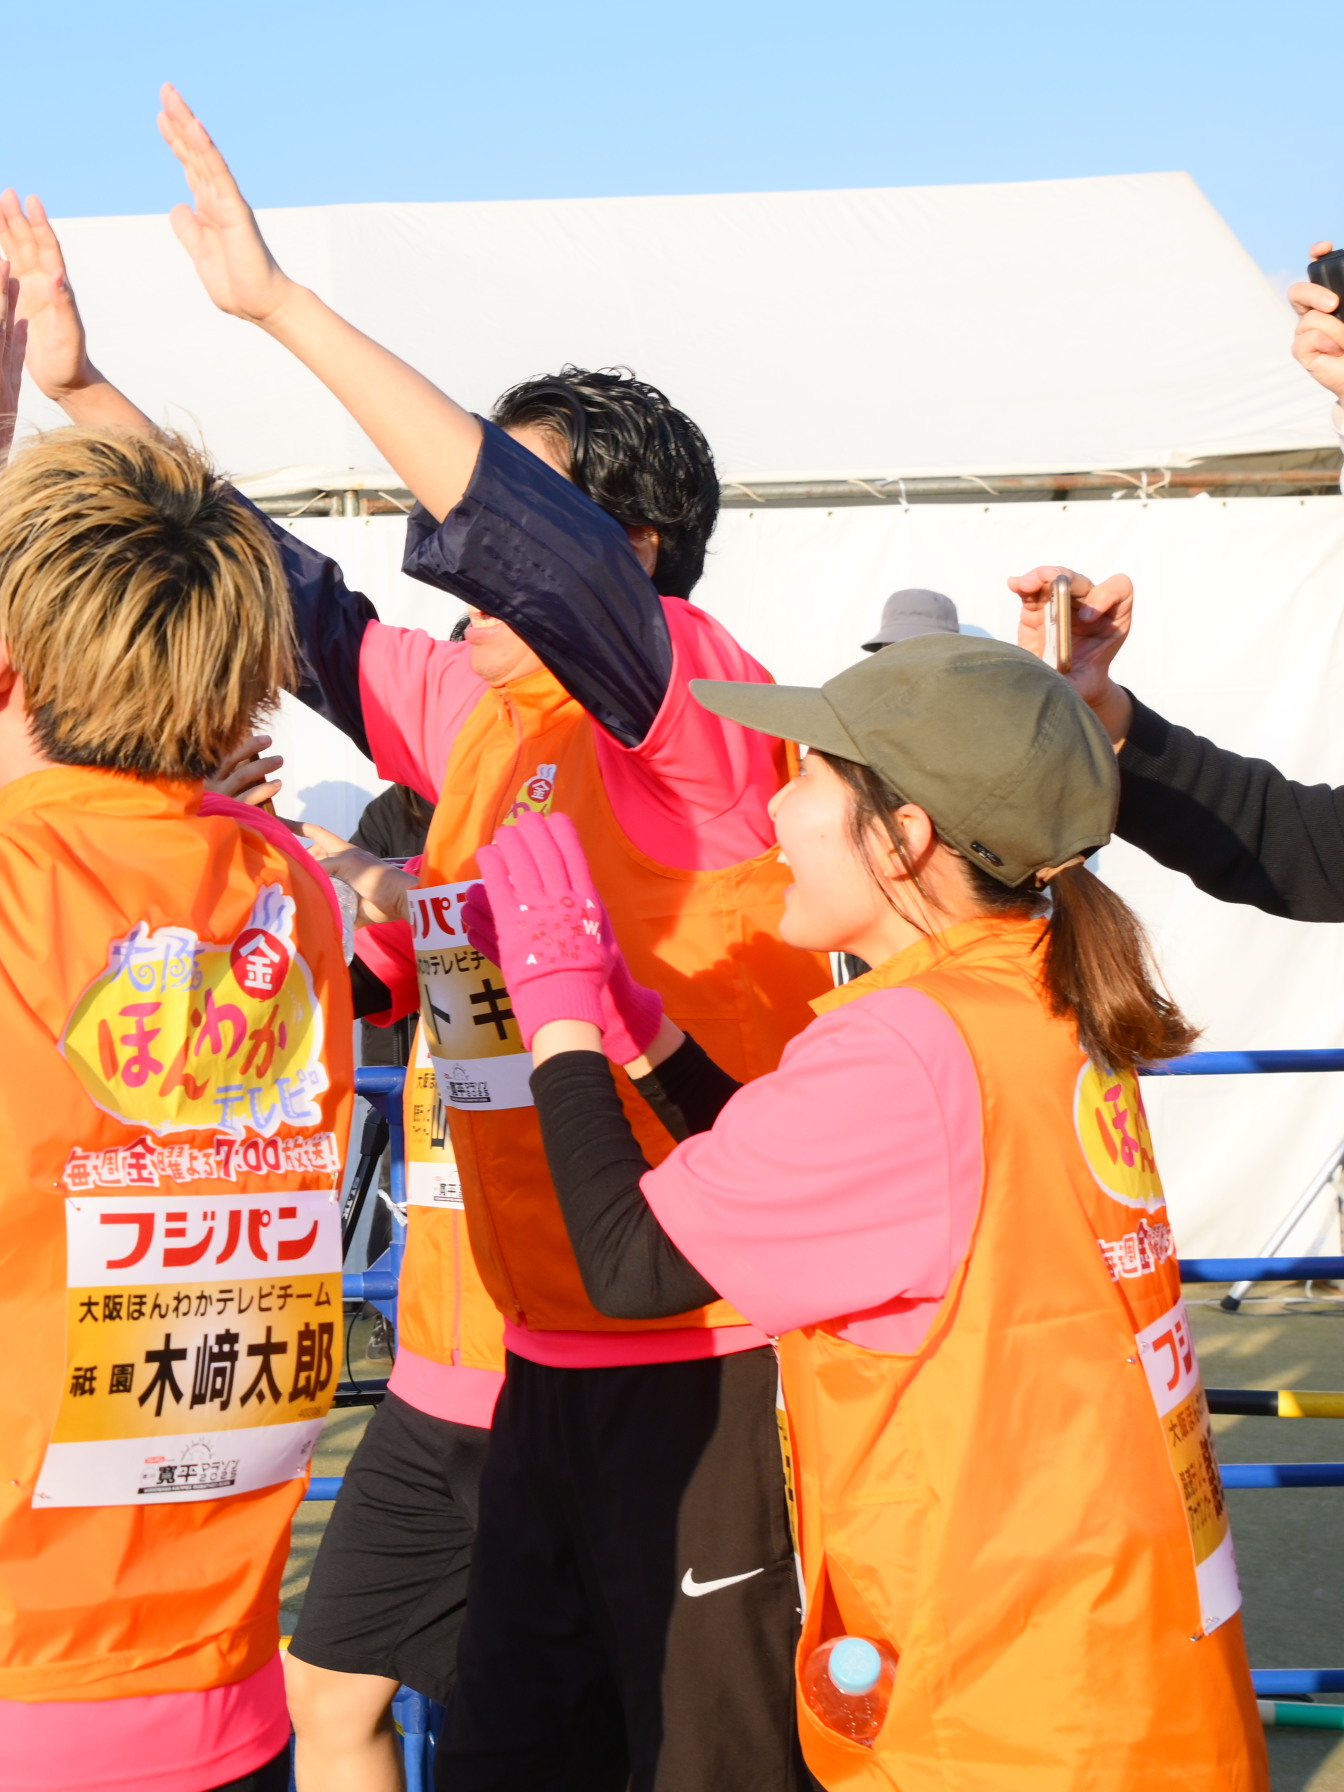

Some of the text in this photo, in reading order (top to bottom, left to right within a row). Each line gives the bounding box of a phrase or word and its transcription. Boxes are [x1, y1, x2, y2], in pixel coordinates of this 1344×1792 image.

[531, 780, 550, 800] 金
[112, 929, 205, 993] 大阪
[239, 934, 280, 990] 金
[97, 988, 287, 1101] ほんわか
[213, 1069, 319, 1130] テレビ
[99, 1205, 319, 1270] フジパン
[78, 1281, 333, 1323] 大阪ほんわかテレビチーム
